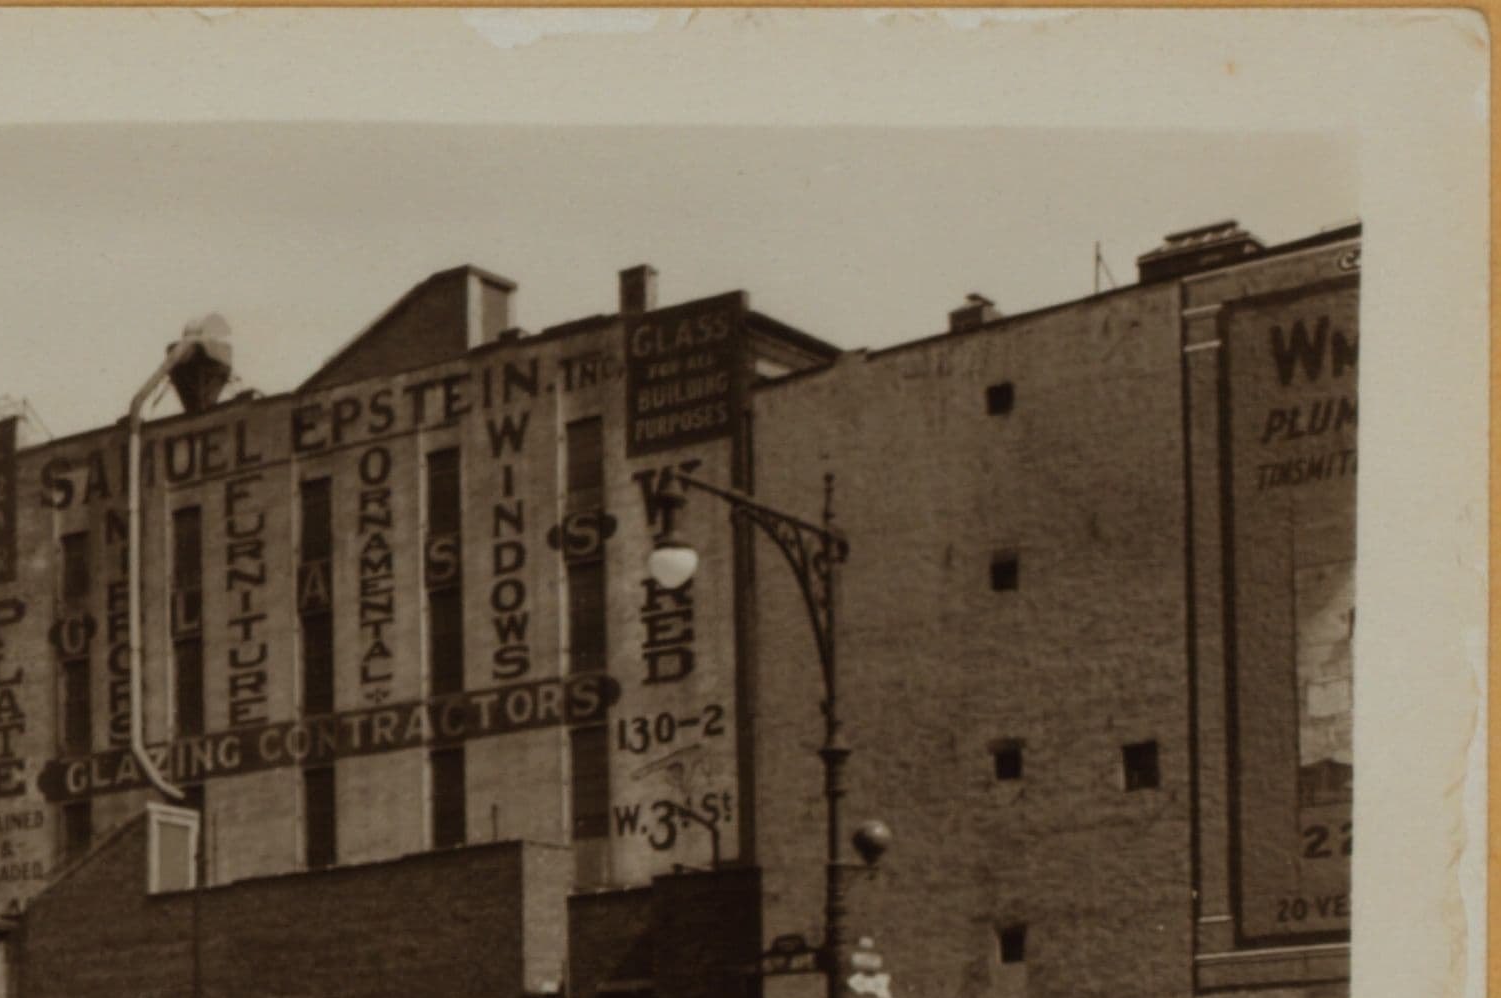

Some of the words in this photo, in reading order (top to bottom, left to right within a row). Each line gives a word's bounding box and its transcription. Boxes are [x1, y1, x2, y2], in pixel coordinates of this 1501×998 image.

[631, 311, 730, 357] GLASS
[636, 371, 730, 414] BUILDING
[633, 400, 729, 443] PURPOSES
[1257, 450, 1357, 491] TINSMIT
[358, 449, 393, 685] ORNAMENTAL
[486, 413, 532, 681] WINDOWS
[225, 474, 268, 726] FURNITURE
[65, 736, 241, 795] GLAZING
[258, 675, 603, 763] CONTRACTORS
[616, 703, 726, 755] 130-2
